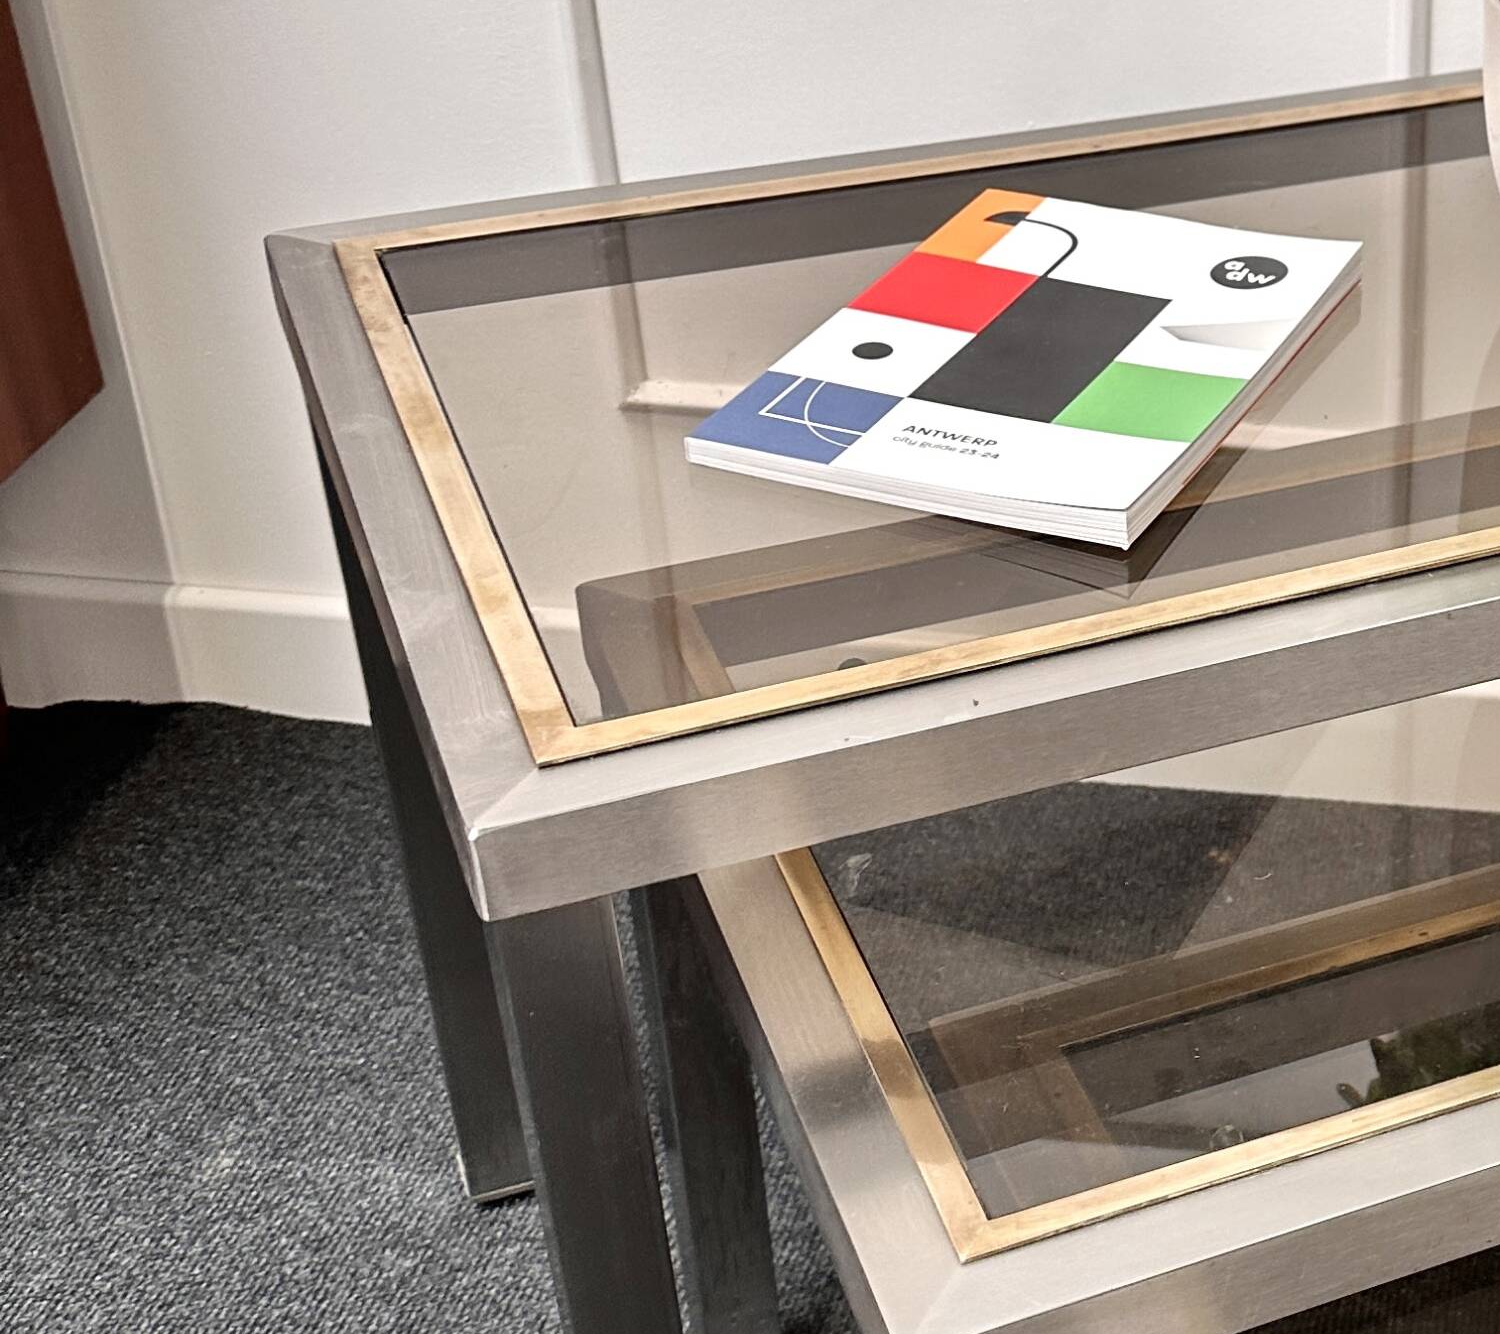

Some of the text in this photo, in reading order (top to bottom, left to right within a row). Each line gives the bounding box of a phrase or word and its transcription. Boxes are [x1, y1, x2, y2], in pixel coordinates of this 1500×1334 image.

[903, 425, 998, 446] ANTWERP
[892, 436, 1000, 459] city guide 23-24
